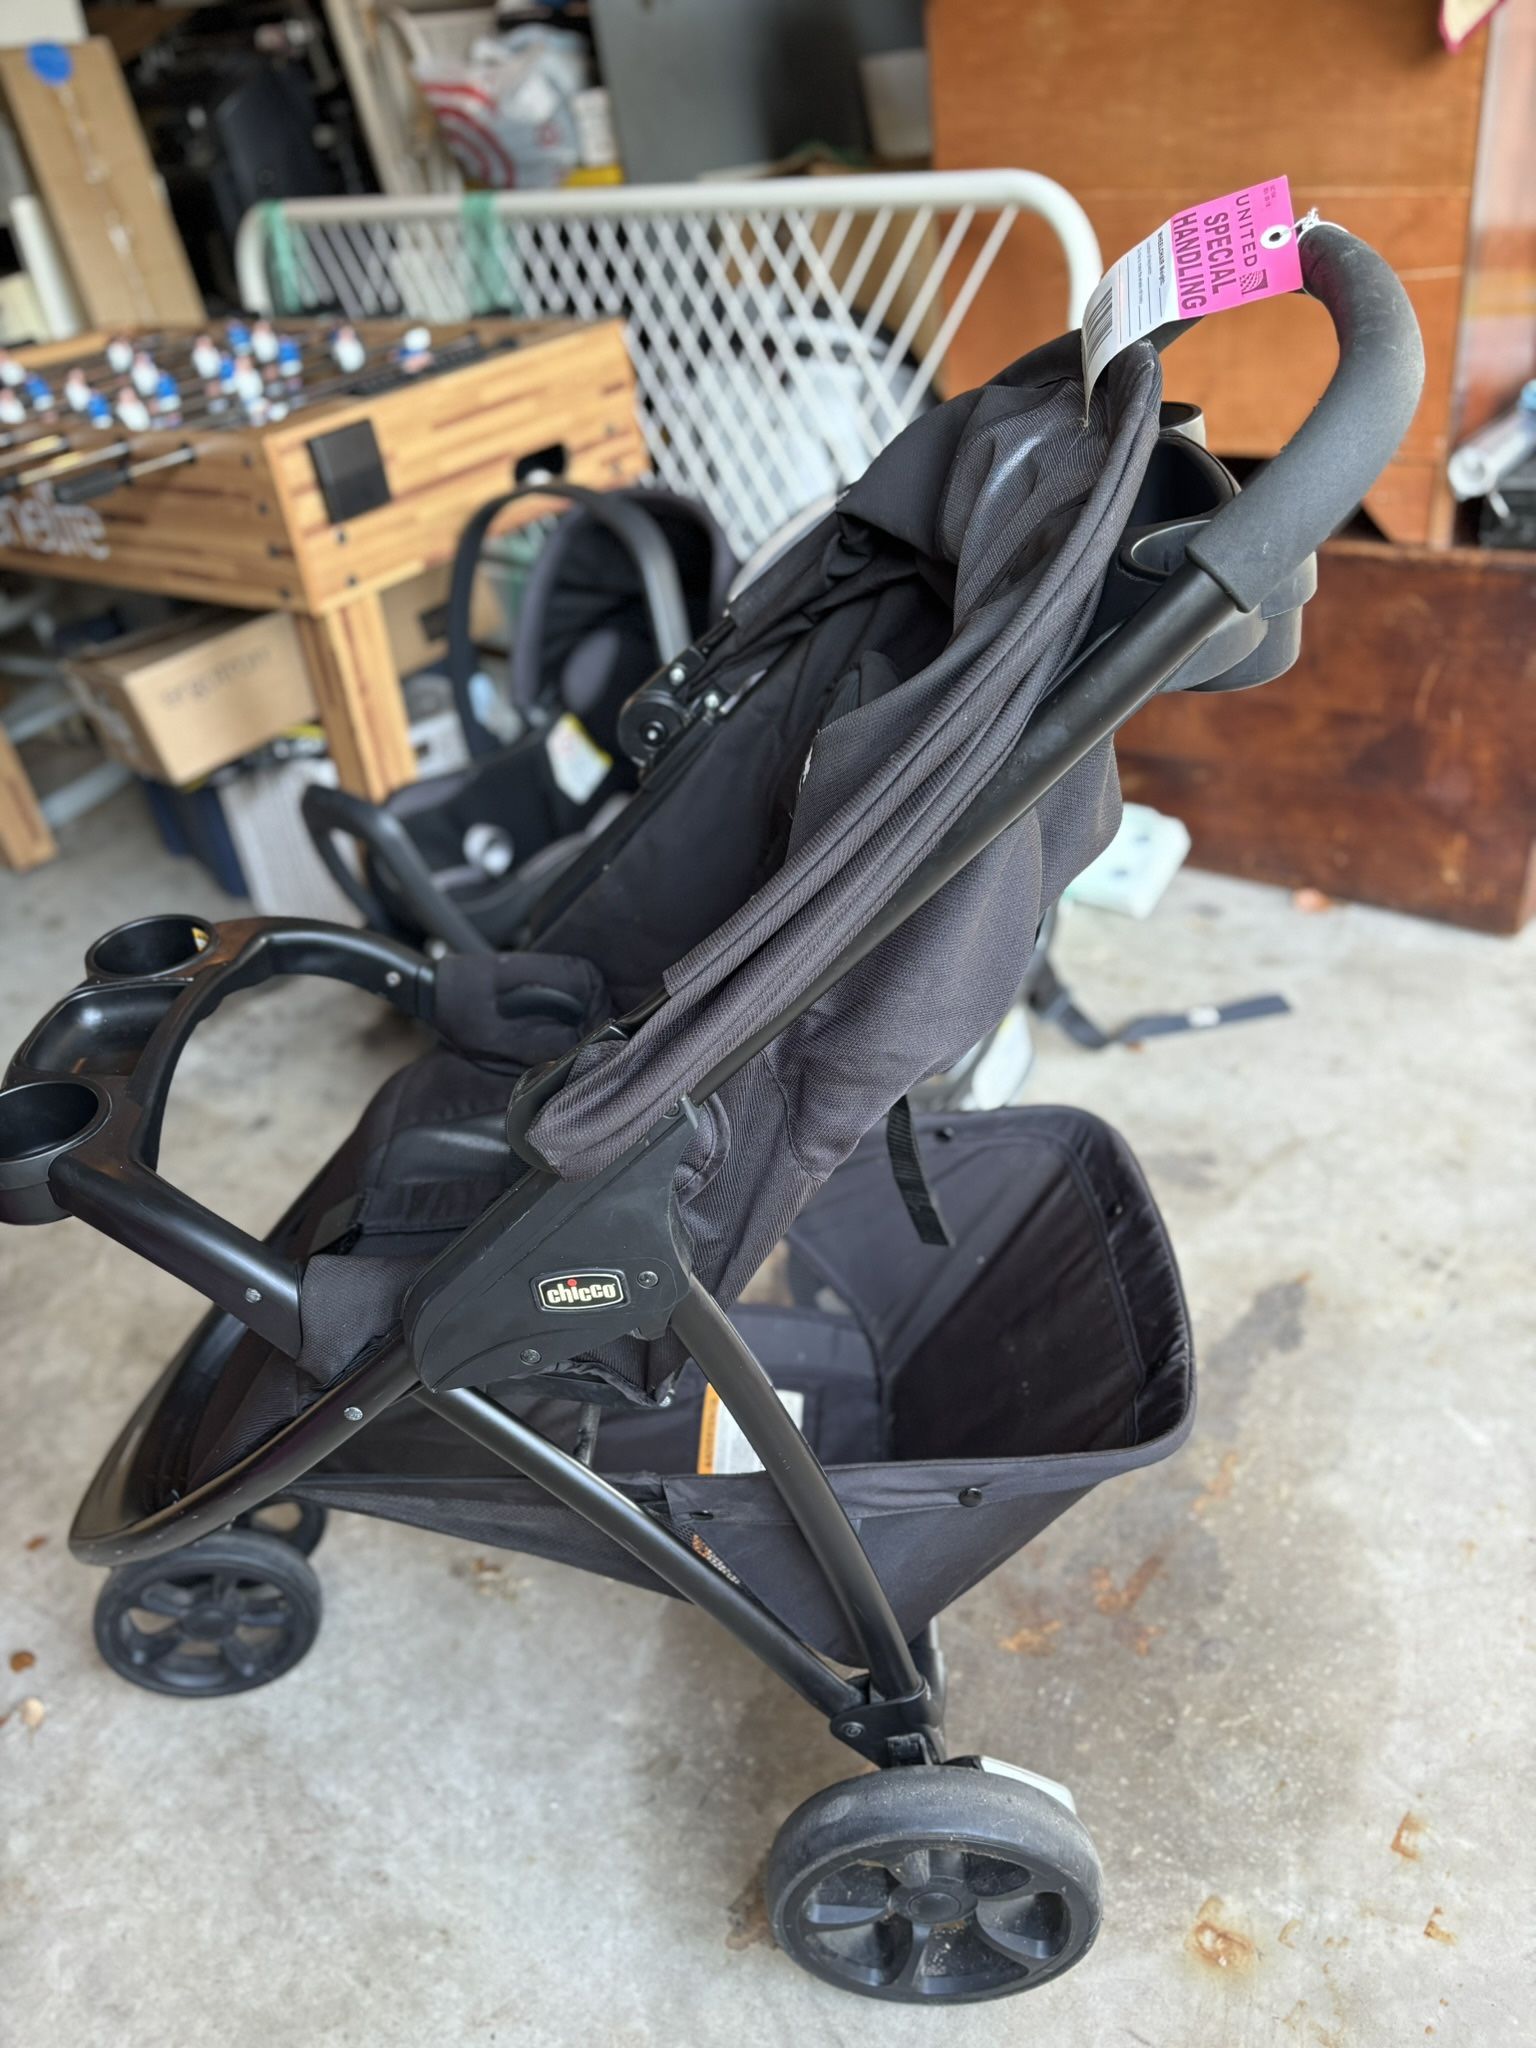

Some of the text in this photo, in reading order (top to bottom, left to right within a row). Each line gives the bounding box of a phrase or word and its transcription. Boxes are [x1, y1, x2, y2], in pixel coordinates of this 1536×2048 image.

[1173, 212, 1207, 310] HANDLING
[1203, 212, 1236, 295] SPECIAL
[1236, 194, 1257, 267] UNITED
[546, 1279, 616, 1303] chicco
